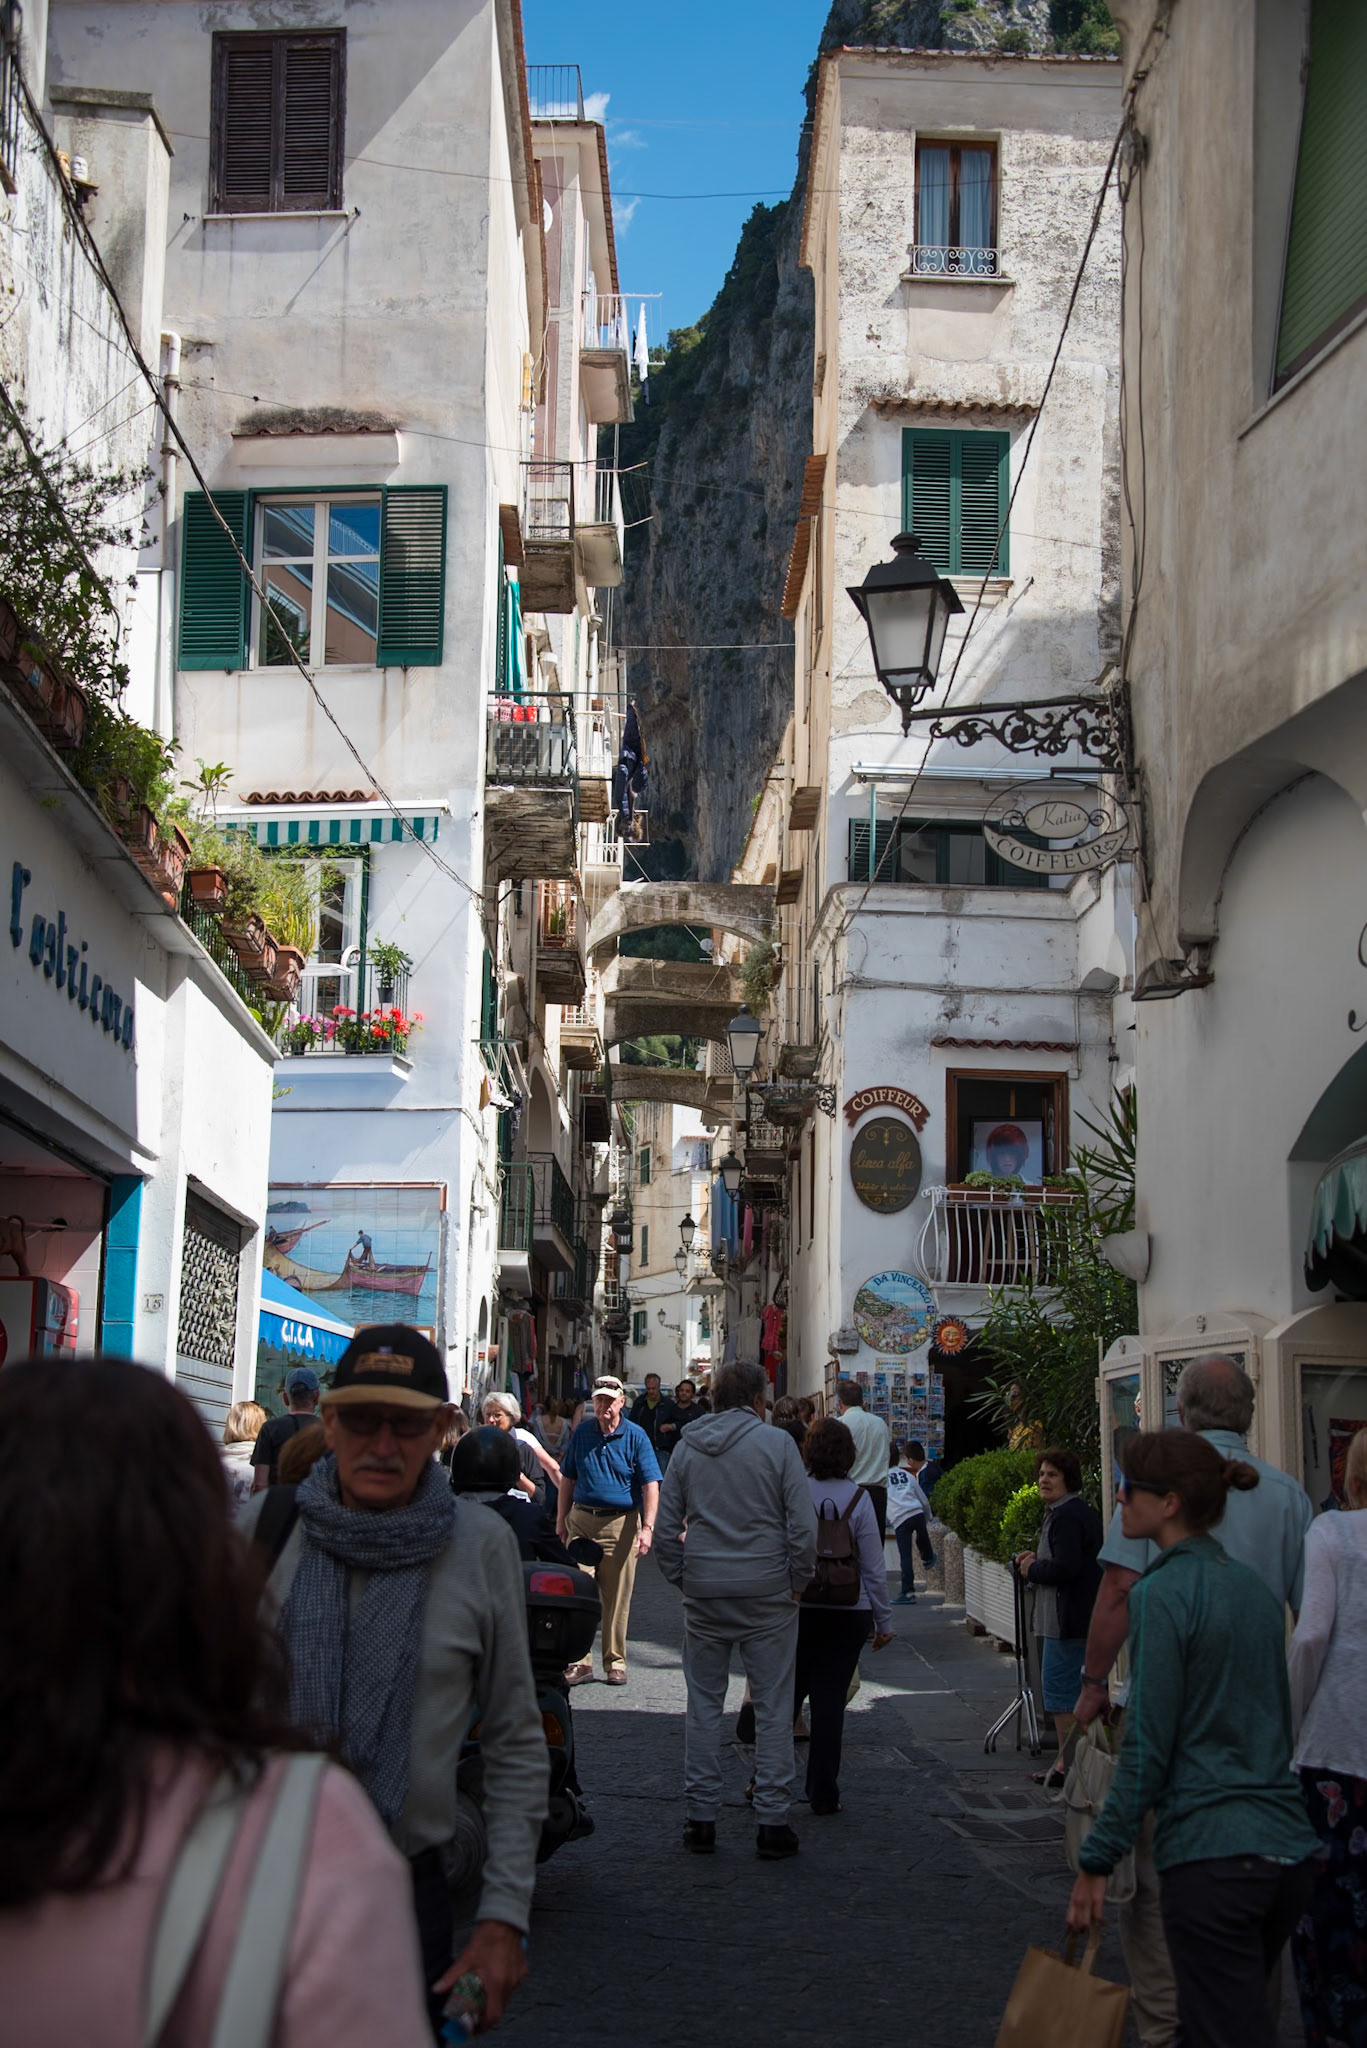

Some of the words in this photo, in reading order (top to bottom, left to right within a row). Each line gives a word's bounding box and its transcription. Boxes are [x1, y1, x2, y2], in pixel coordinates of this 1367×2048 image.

[1031, 804, 1082, 830] Katia
[996, 838, 1107, 869] COIFFEUR
[852, 1089, 922, 1118] COIFFEUR
[888, 1151, 915, 1177] alfa
[873, 1274, 888, 1287] DA
[891, 1272, 932, 1304] VINCENZO
[145, 1299, 162, 1309] 15
[889, 1471, 909, 1485] 83
